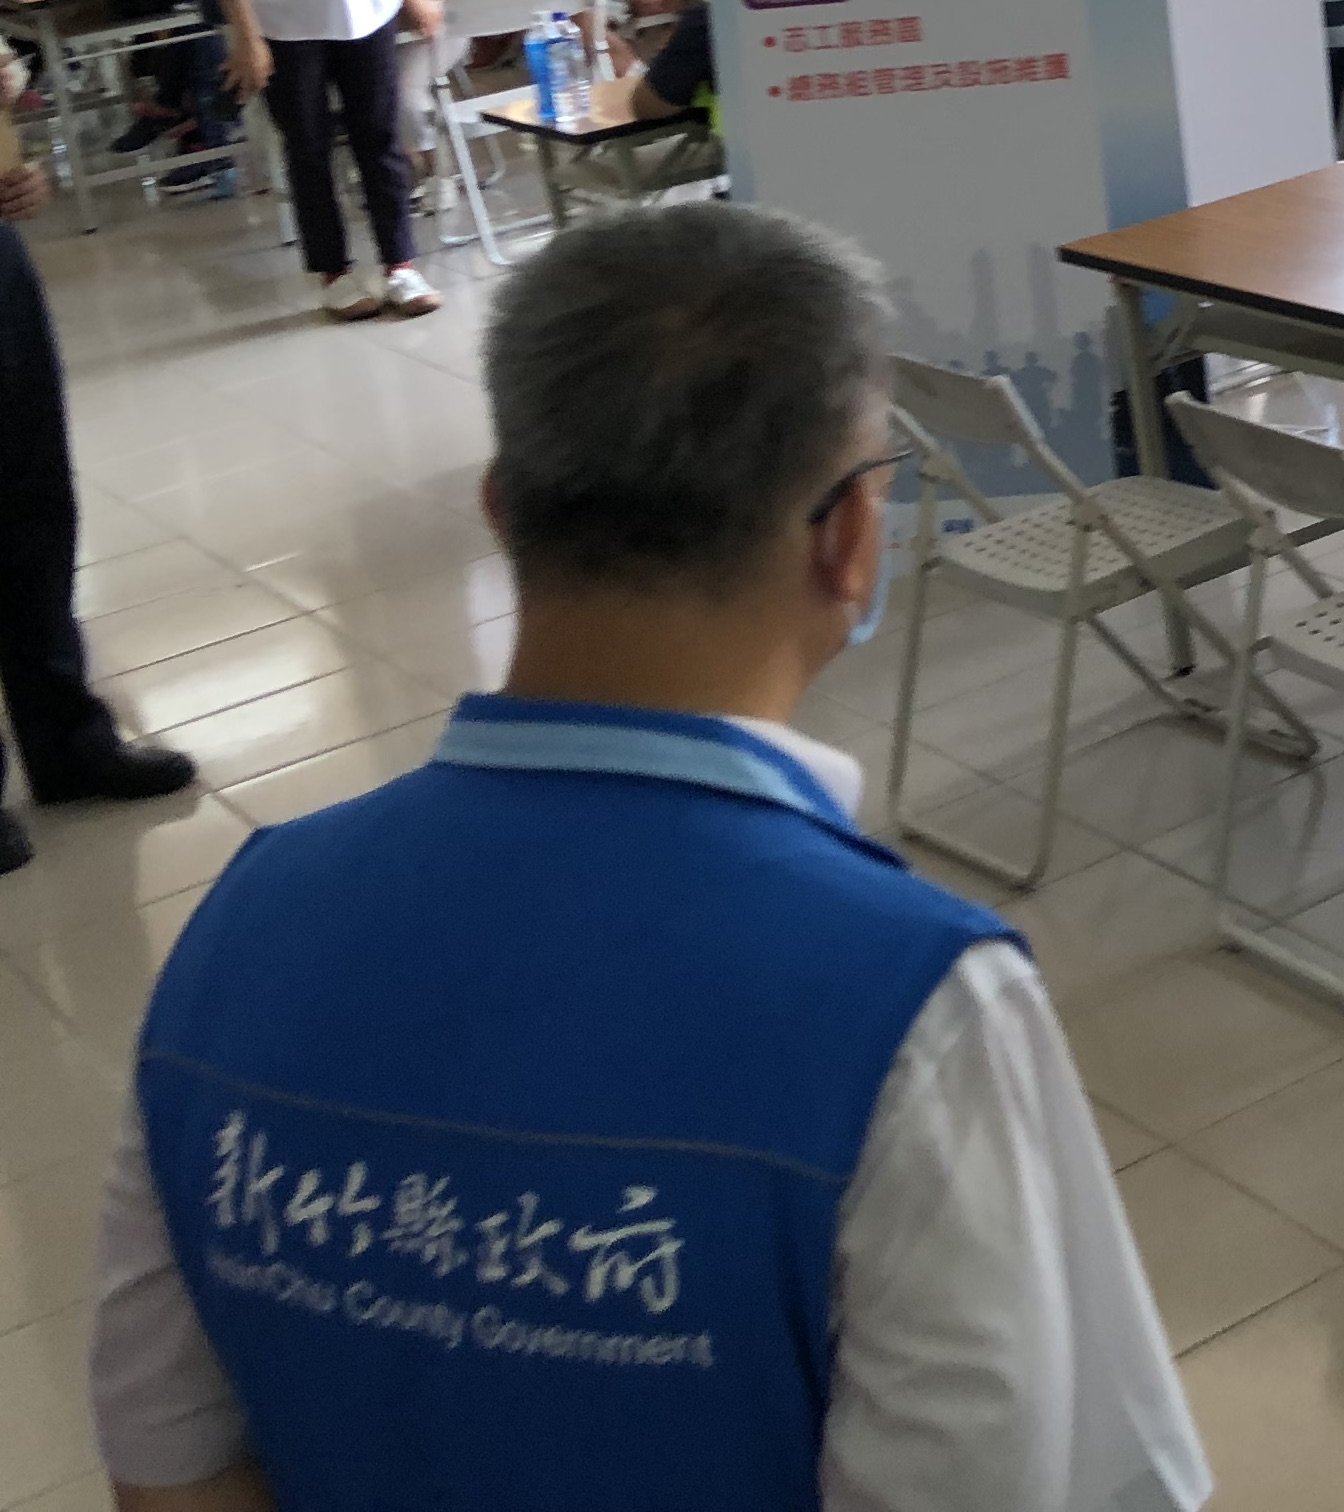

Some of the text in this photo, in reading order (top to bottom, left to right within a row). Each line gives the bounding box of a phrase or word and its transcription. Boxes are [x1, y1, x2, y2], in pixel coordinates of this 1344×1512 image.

[782, 15, 922, 53] 志工服務區
[206, 1107, 686, 1314] 新竹縣政府
